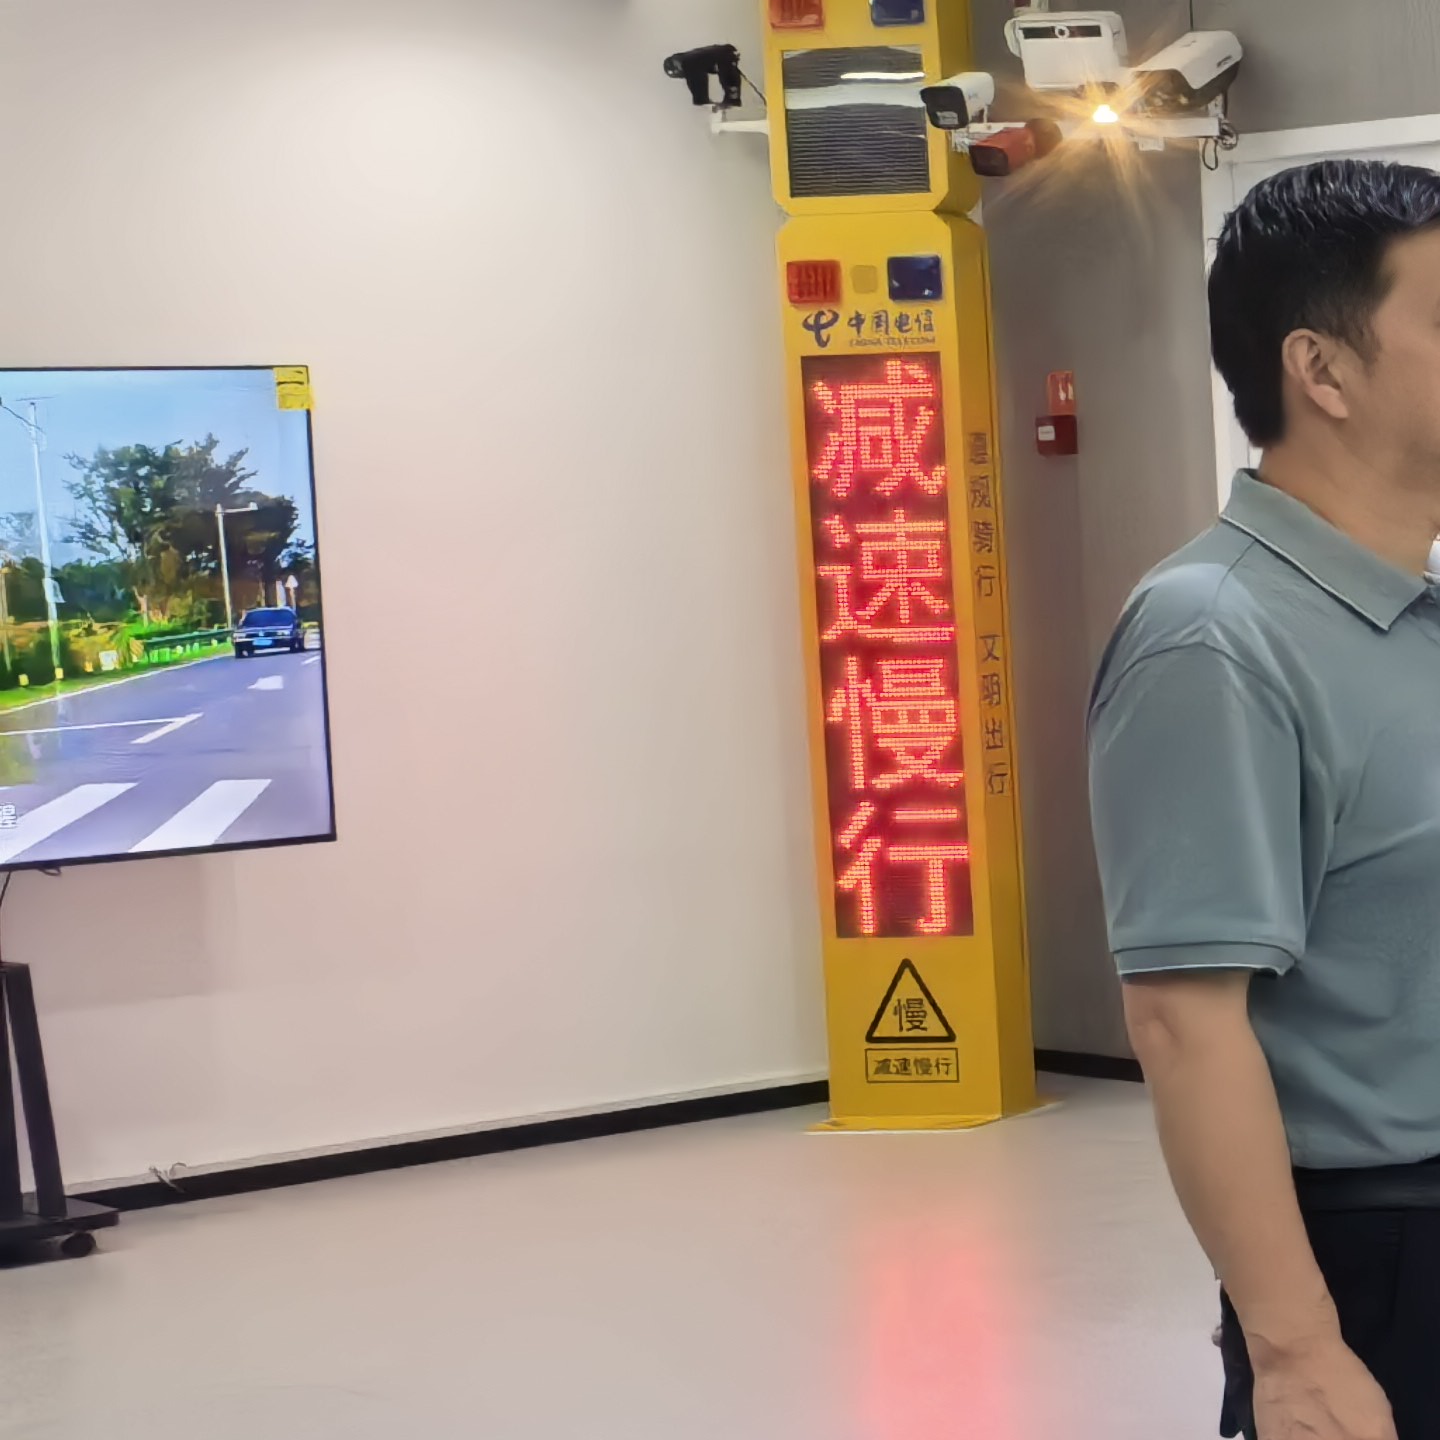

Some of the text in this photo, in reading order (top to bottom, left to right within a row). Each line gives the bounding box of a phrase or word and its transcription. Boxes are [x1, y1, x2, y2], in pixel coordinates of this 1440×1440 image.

[848, 309, 934, 336] 中国电信
[812, 359, 969, 935] 减速慢行
[893, 998, 928, 1033] 慢
